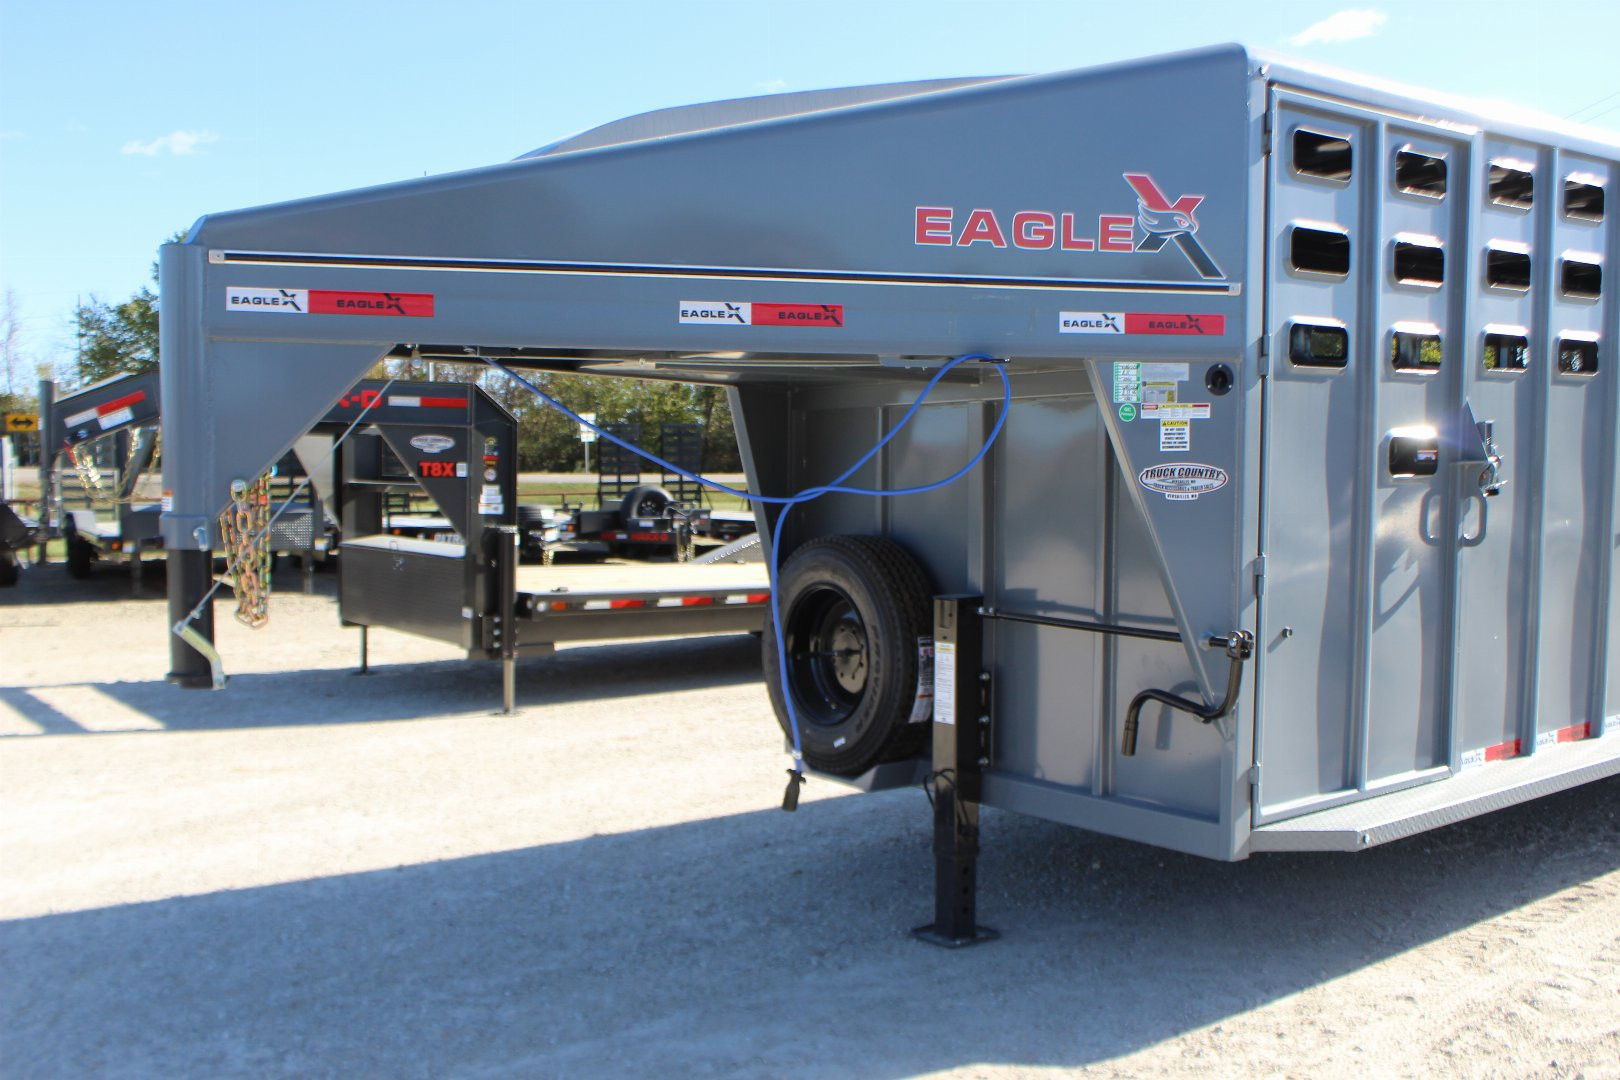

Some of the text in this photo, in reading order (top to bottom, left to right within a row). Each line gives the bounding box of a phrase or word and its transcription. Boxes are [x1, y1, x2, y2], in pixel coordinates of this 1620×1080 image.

[419, 461, 455, 477] T8X
[1145, 467, 1222, 480] TRUCK COUNTRY
